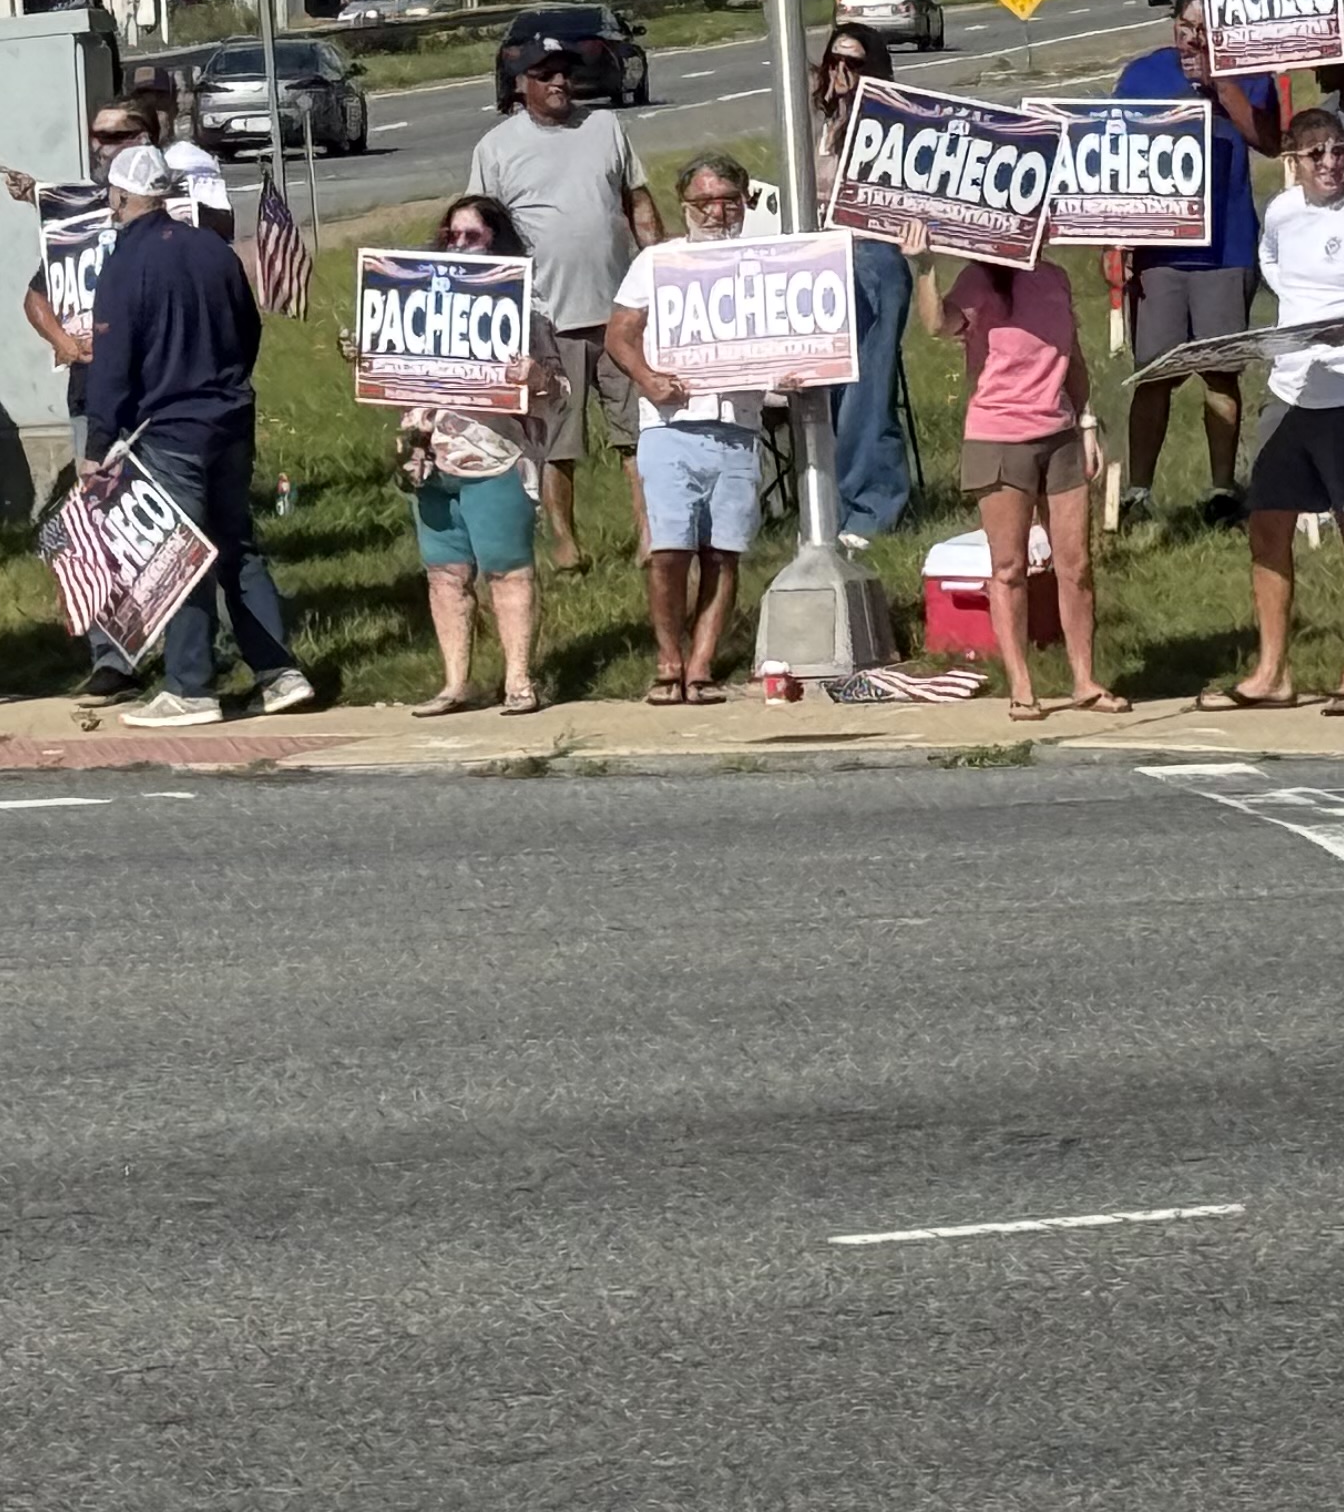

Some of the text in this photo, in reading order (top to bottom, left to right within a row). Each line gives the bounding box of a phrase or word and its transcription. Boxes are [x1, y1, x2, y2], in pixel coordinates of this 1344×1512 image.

[847, 118, 1048, 215] PACHECO
[1050, 133, 1203, 196] ACHECO
[362, 288, 521, 363] PACHECO
[657, 270, 847, 348] PACHECO
[92, 479, 177, 588] HECO
